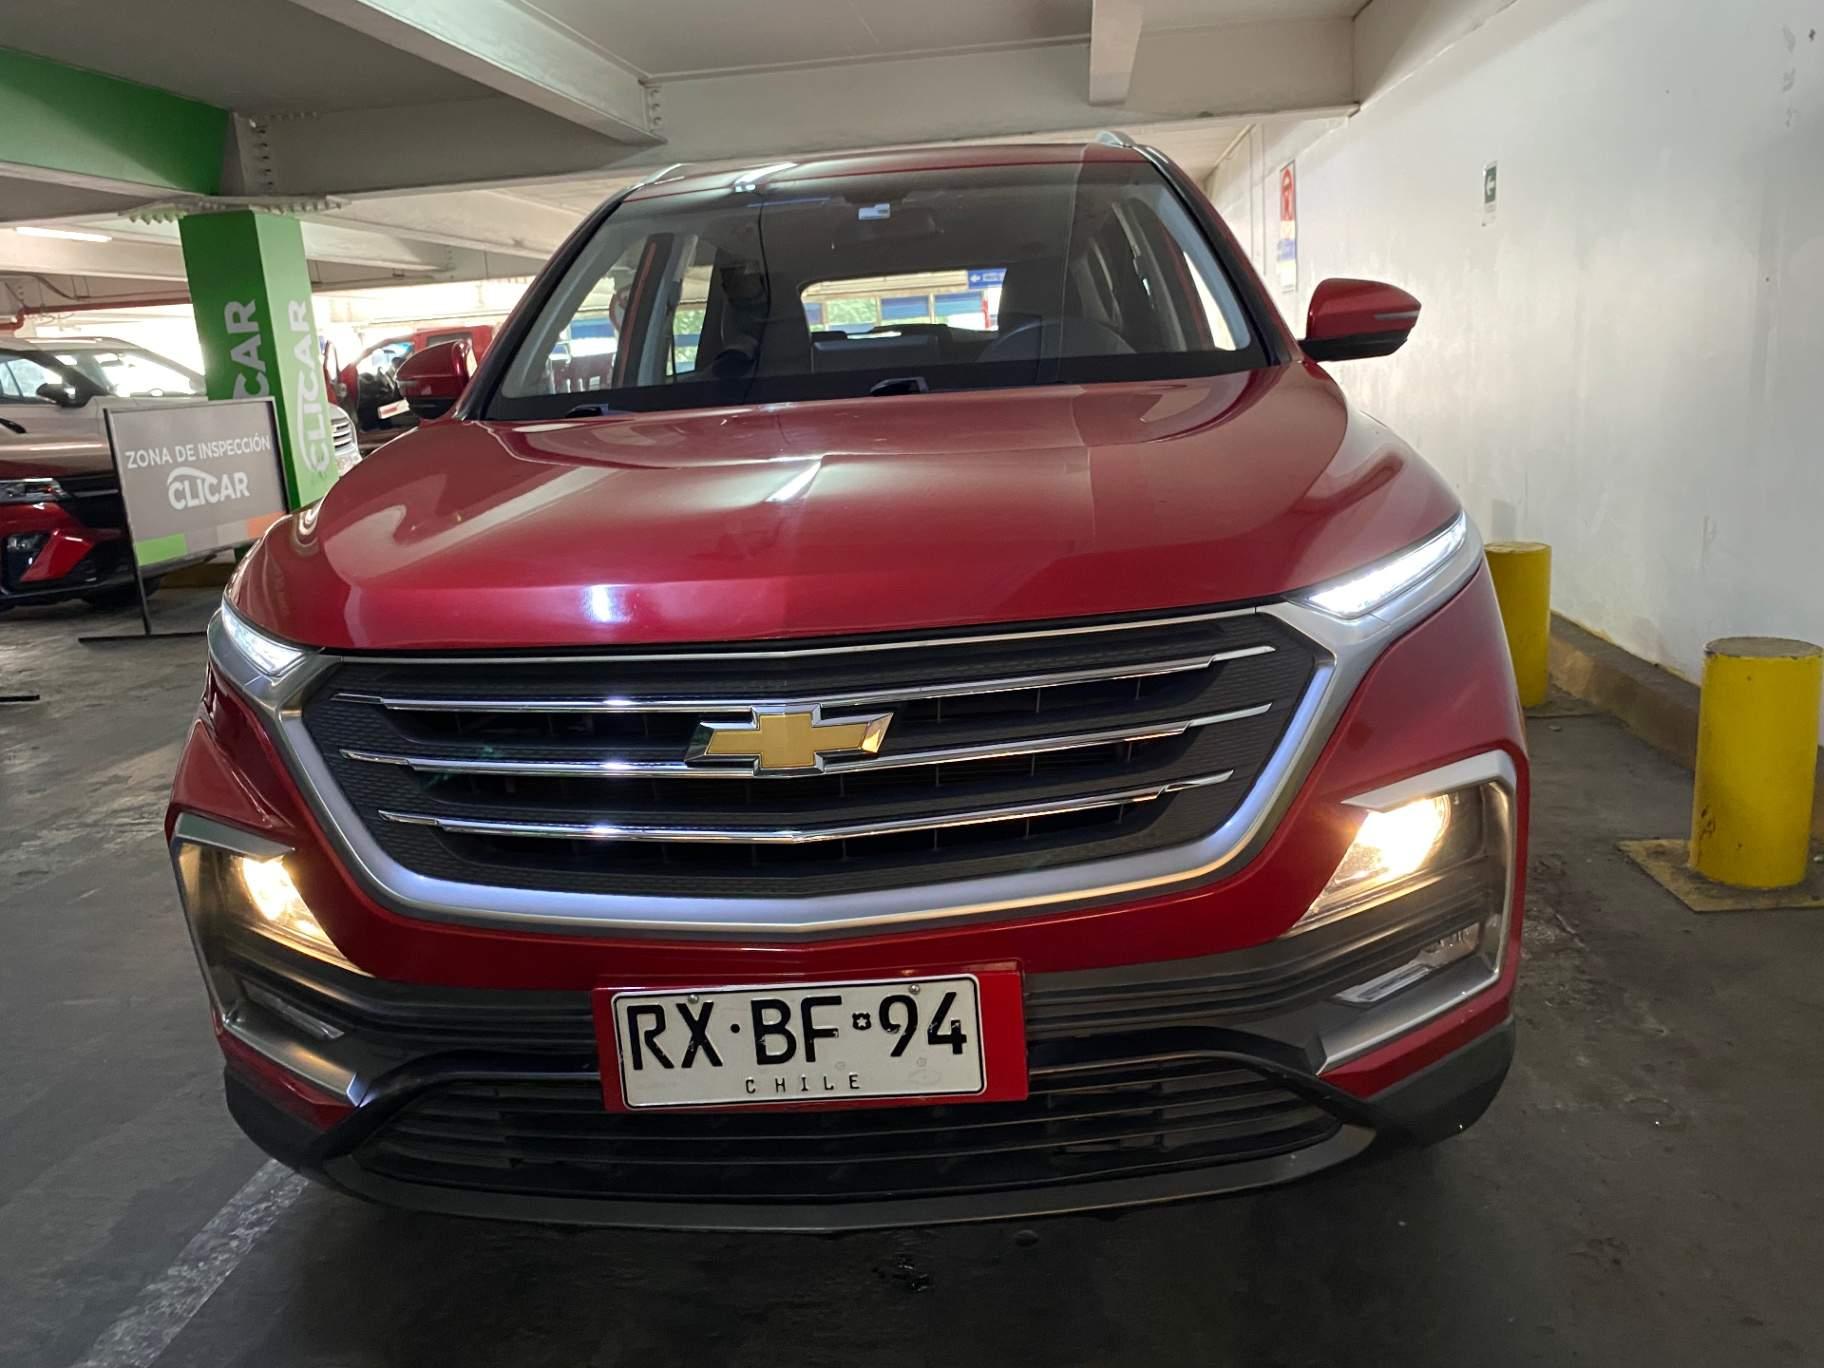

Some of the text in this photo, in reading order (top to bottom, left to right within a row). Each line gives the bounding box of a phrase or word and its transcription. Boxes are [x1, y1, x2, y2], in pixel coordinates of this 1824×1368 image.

[287, 299, 330, 474] CLICAR
[125, 432, 271, 469] ZONA DE INSPECCIÓN
[166, 466, 250, 510] CLICAR
[744, 1073, 861, 1095] CHILE
